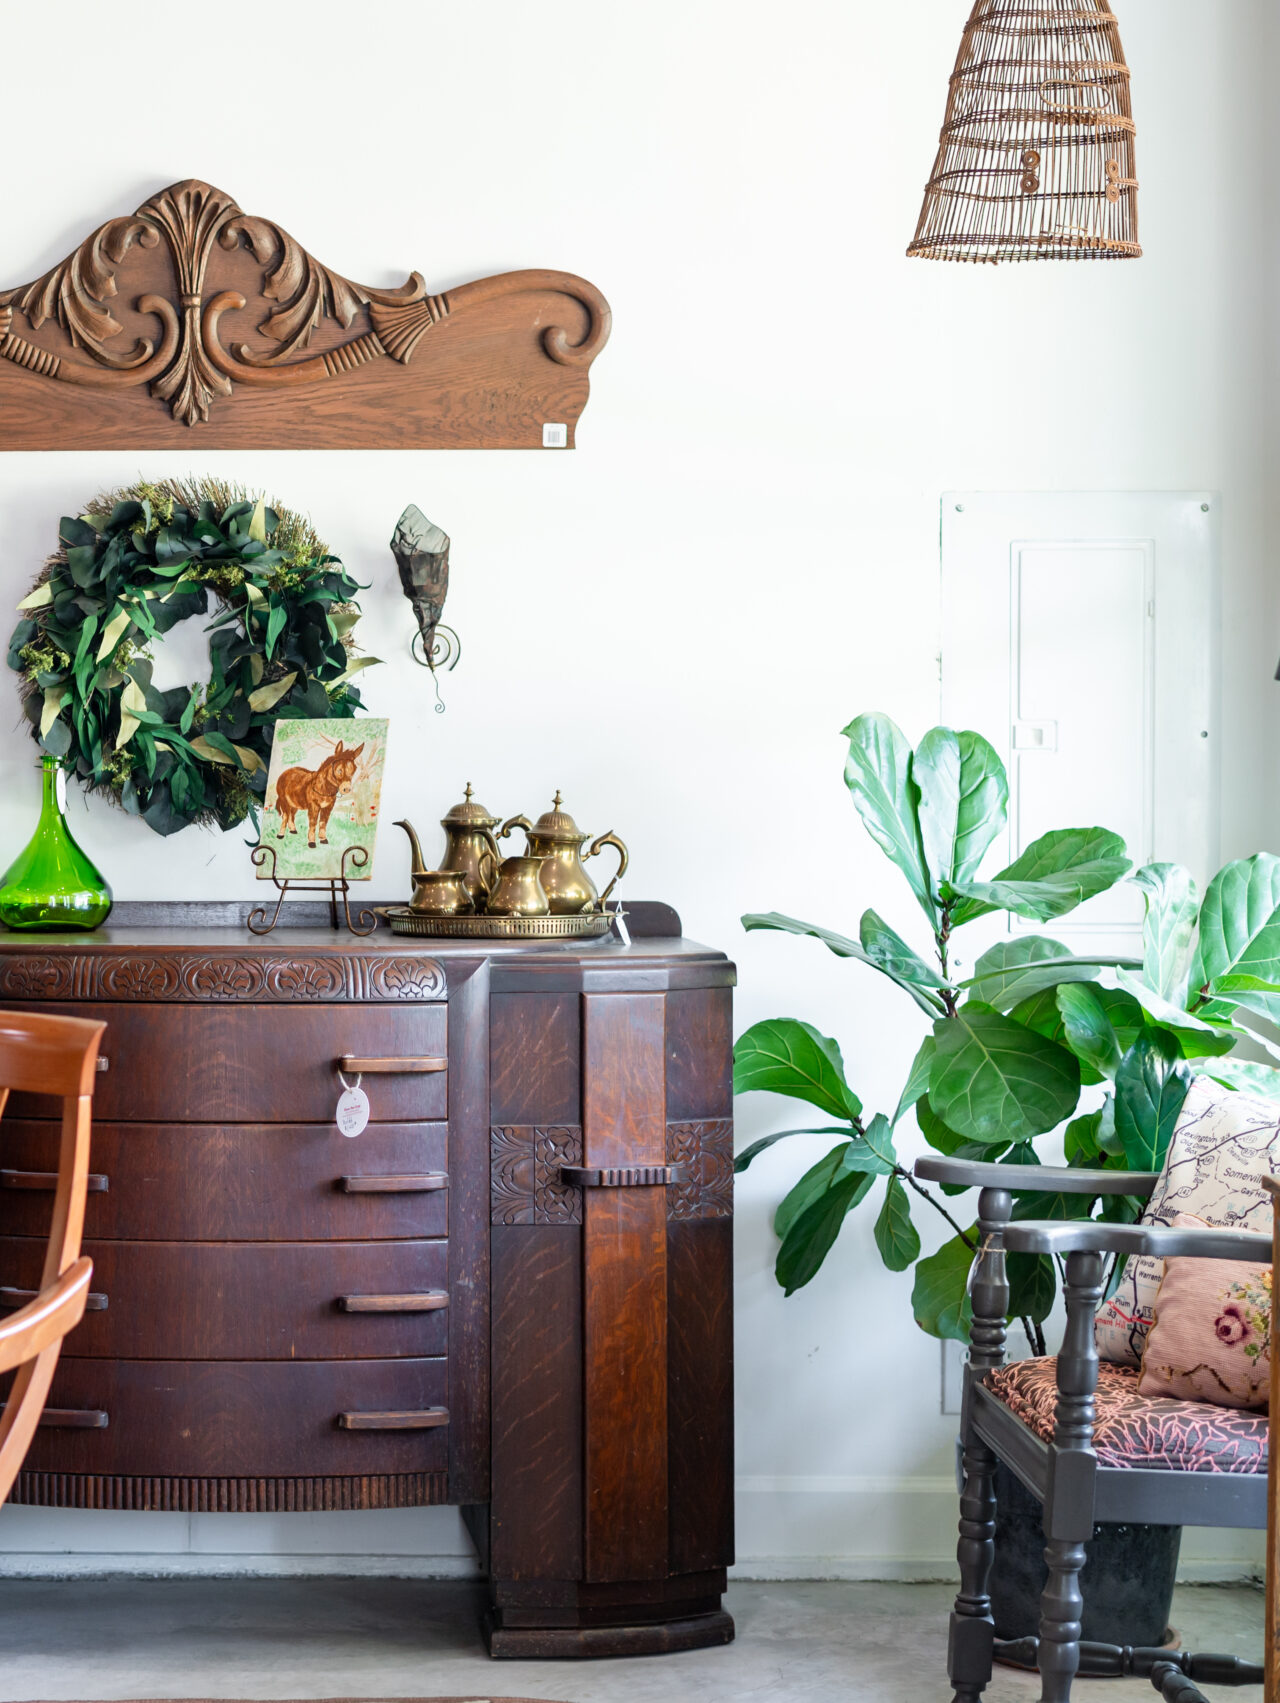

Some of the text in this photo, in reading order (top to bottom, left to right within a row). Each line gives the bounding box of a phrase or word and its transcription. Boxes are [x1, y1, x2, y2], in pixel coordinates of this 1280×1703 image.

[1179, 1129, 1218, 1143] Lexington
[1240, 1187, 1268, 1200] Gay Hill
[1206, 1215, 1230, 1227] Burton
[1115, 1297, 1130, 1307] Plum
[1106, 1307, 1117, 1319] 33
[1115, 1319, 1127, 1330] Hill
